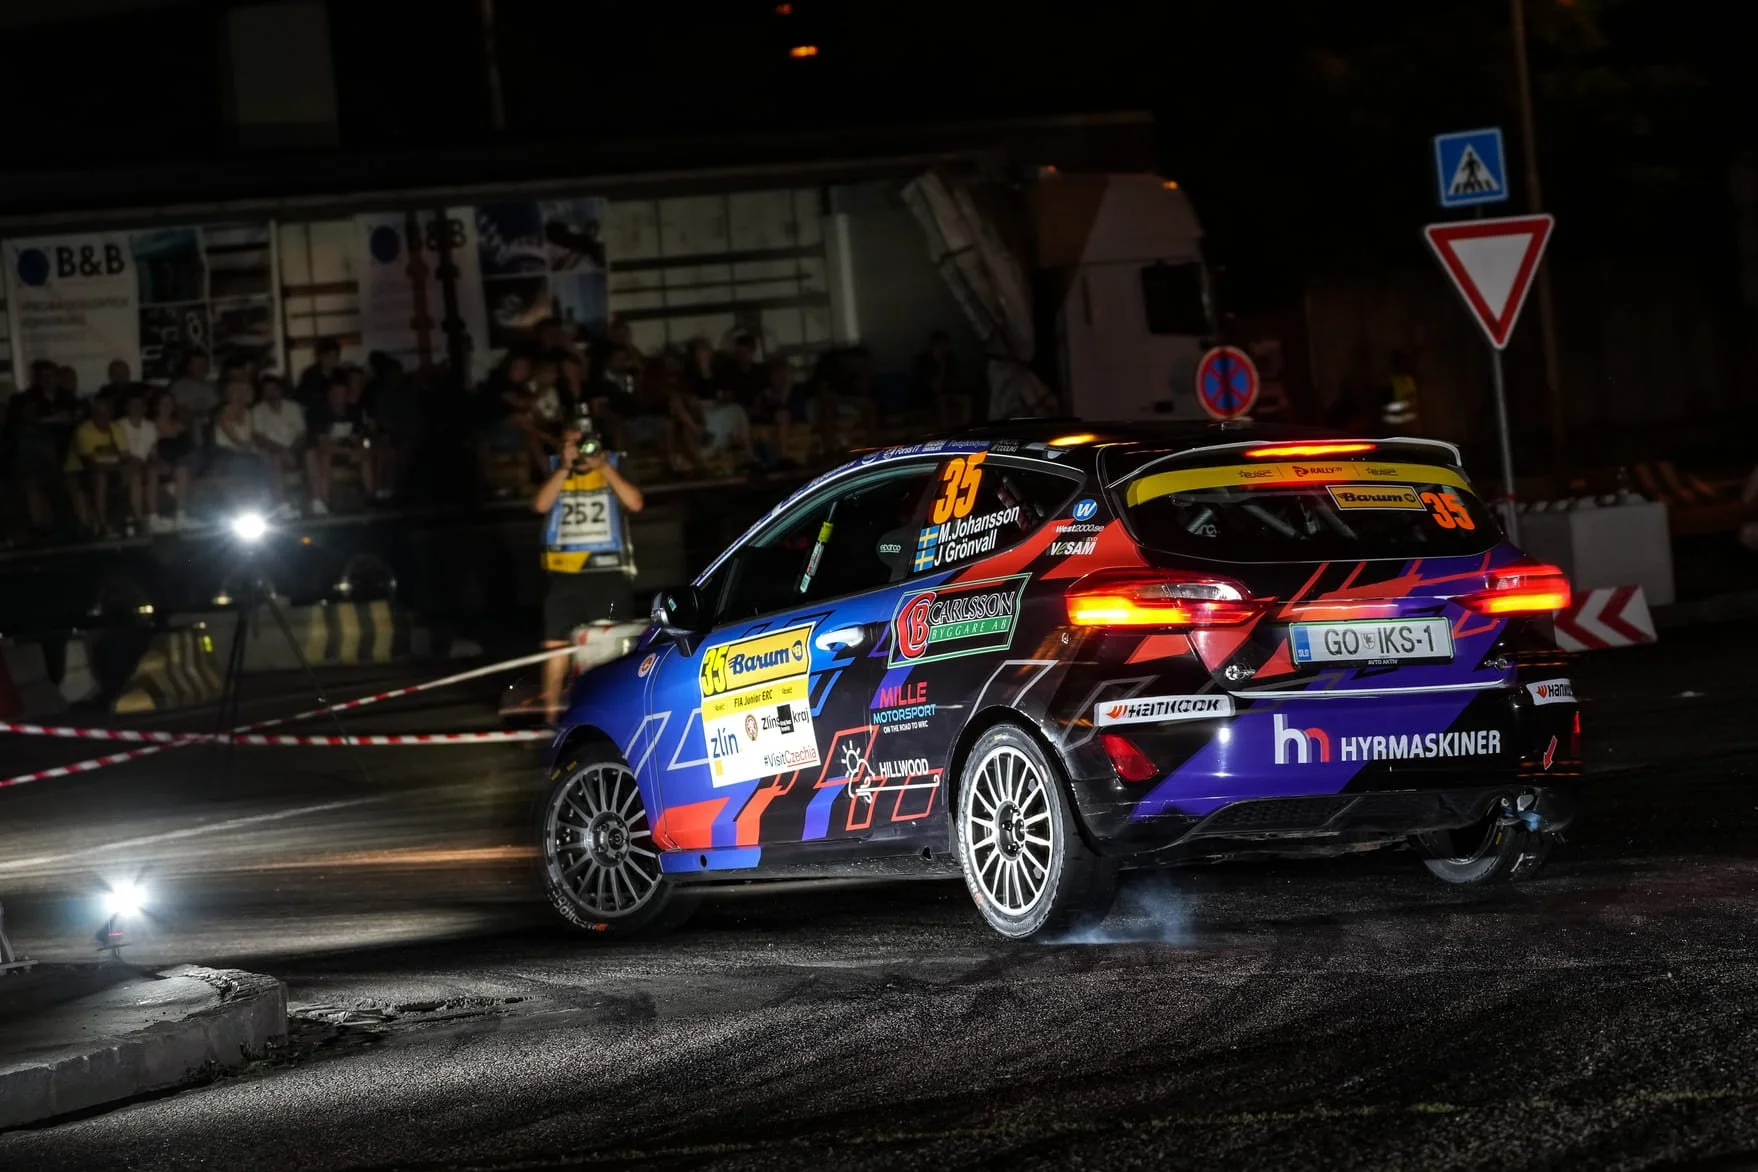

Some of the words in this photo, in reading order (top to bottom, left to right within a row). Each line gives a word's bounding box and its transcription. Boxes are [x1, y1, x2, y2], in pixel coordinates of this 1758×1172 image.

[56, 243, 125, 277] B&B
[933, 451, 988, 525] 35
[1338, 491, 1402, 503] Barum
[562, 501, 606, 525] 252
[1077, 502, 1097, 517] W
[1419, 491, 1475, 531] 35
[938, 505, 1020, 544] M.Johansson
[934, 544, 943, 566] J
[945, 529, 997, 564] Grönvall
[929, 591, 1015, 625] CARLSSON
[931, 621, 985, 640] BYGGARE
[991, 618, 1007, 631] AB
[1324, 628, 1359, 656] GO
[1377, 625, 1435, 654] IKS-1
[701, 645, 730, 696] 35
[730, 647, 790, 675] Barum
[734, 698, 743, 708] FIA
[744, 694, 761, 706] Junior
[762, 689, 773, 701] ERC
[880, 681, 927, 709] MILLE
[792, 707, 810, 724] kraj
[873, 703, 936, 724] MOTORSPORT
[883, 726, 890, 734] ON
[891, 724, 899, 732] THE
[900, 723, 911, 731] ROAD
[911, 721, 918, 729] TO
[918, 720, 928, 728] WRC
[711, 728, 739, 759] zlín
[764, 746, 817, 768] #VisitCzechia
[1341, 729, 1501, 762] HYRMASKINER
[879, 758, 928, 777] HILLWOOD
